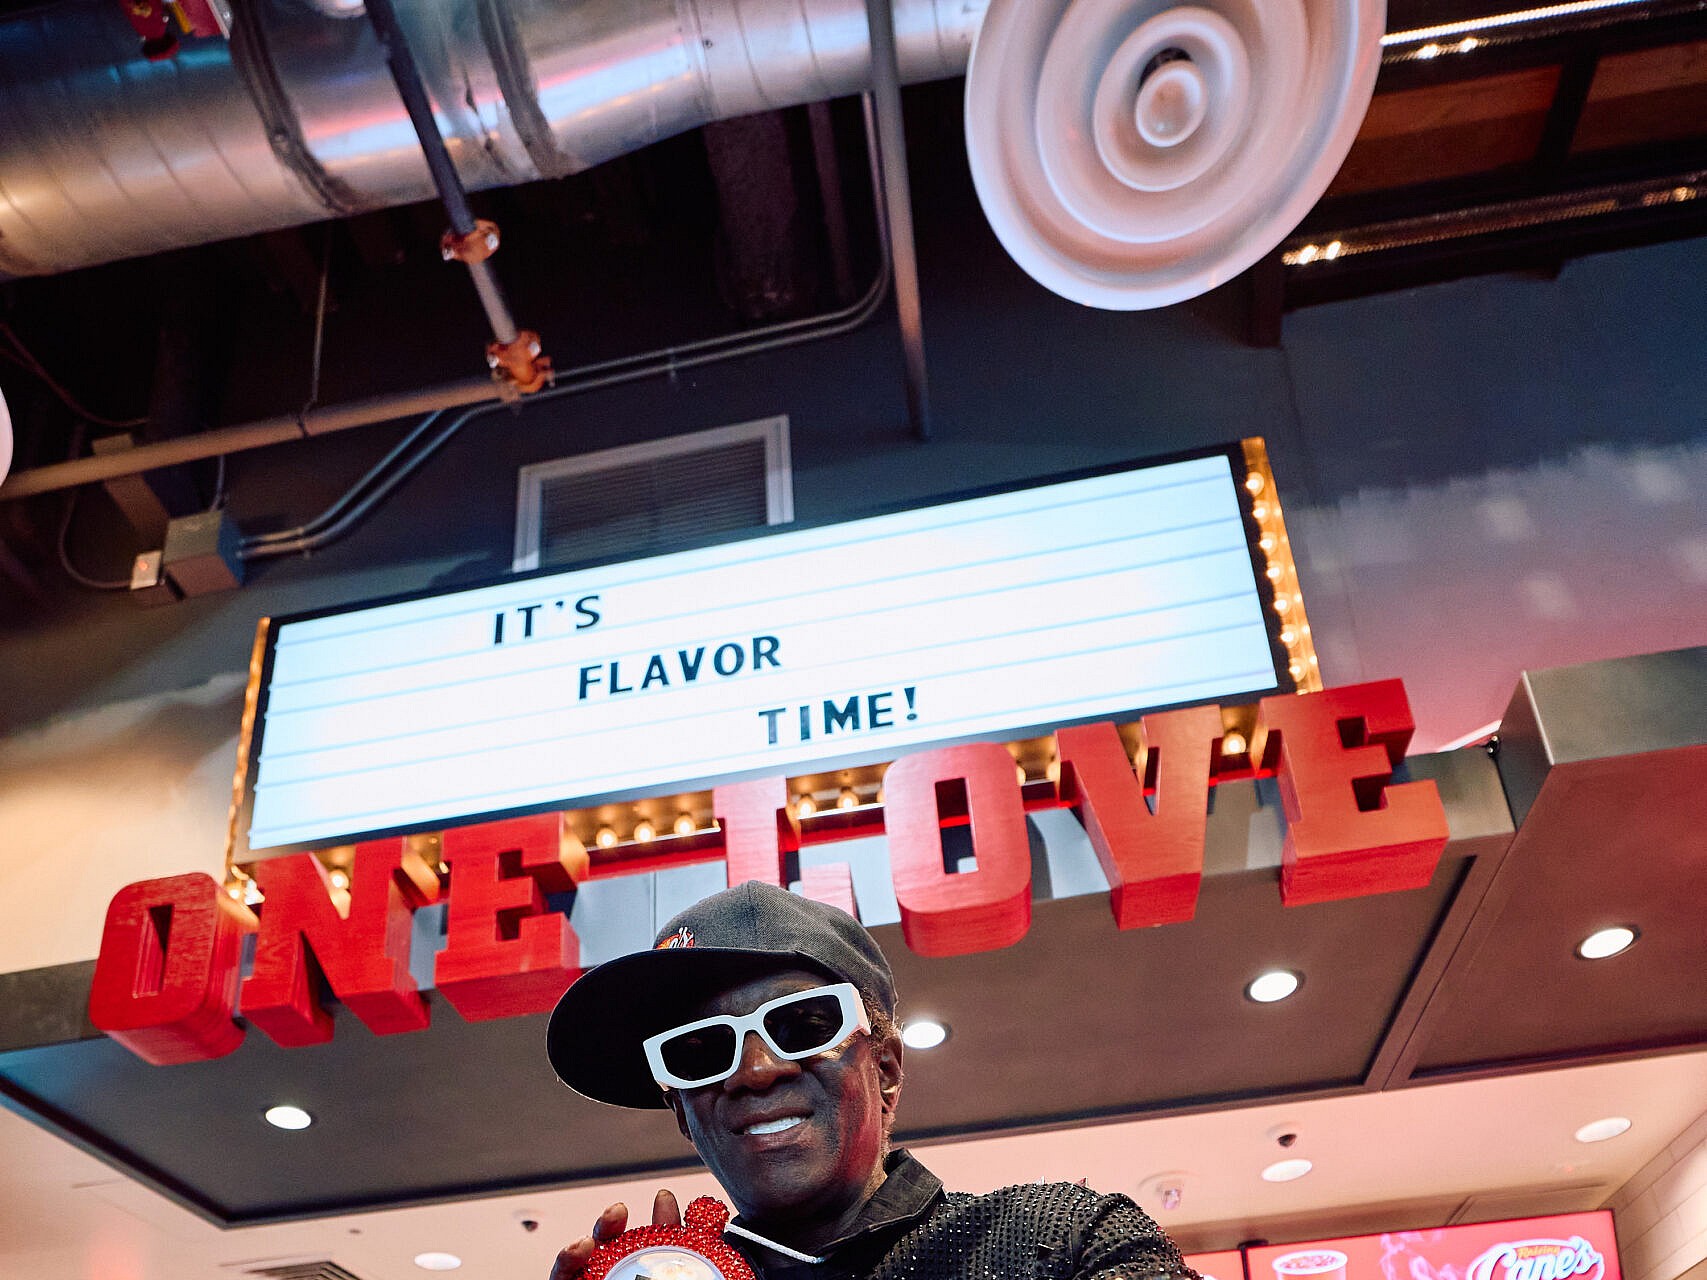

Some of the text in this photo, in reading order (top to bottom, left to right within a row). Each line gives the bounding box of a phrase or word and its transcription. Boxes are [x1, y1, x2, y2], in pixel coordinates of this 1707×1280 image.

[494, 595, 600, 645] IT'S
[578, 635, 781, 700] FLAVOR
[758, 686, 918, 744] TIME!
[90, 679, 1450, 1066] ONE LOVE
